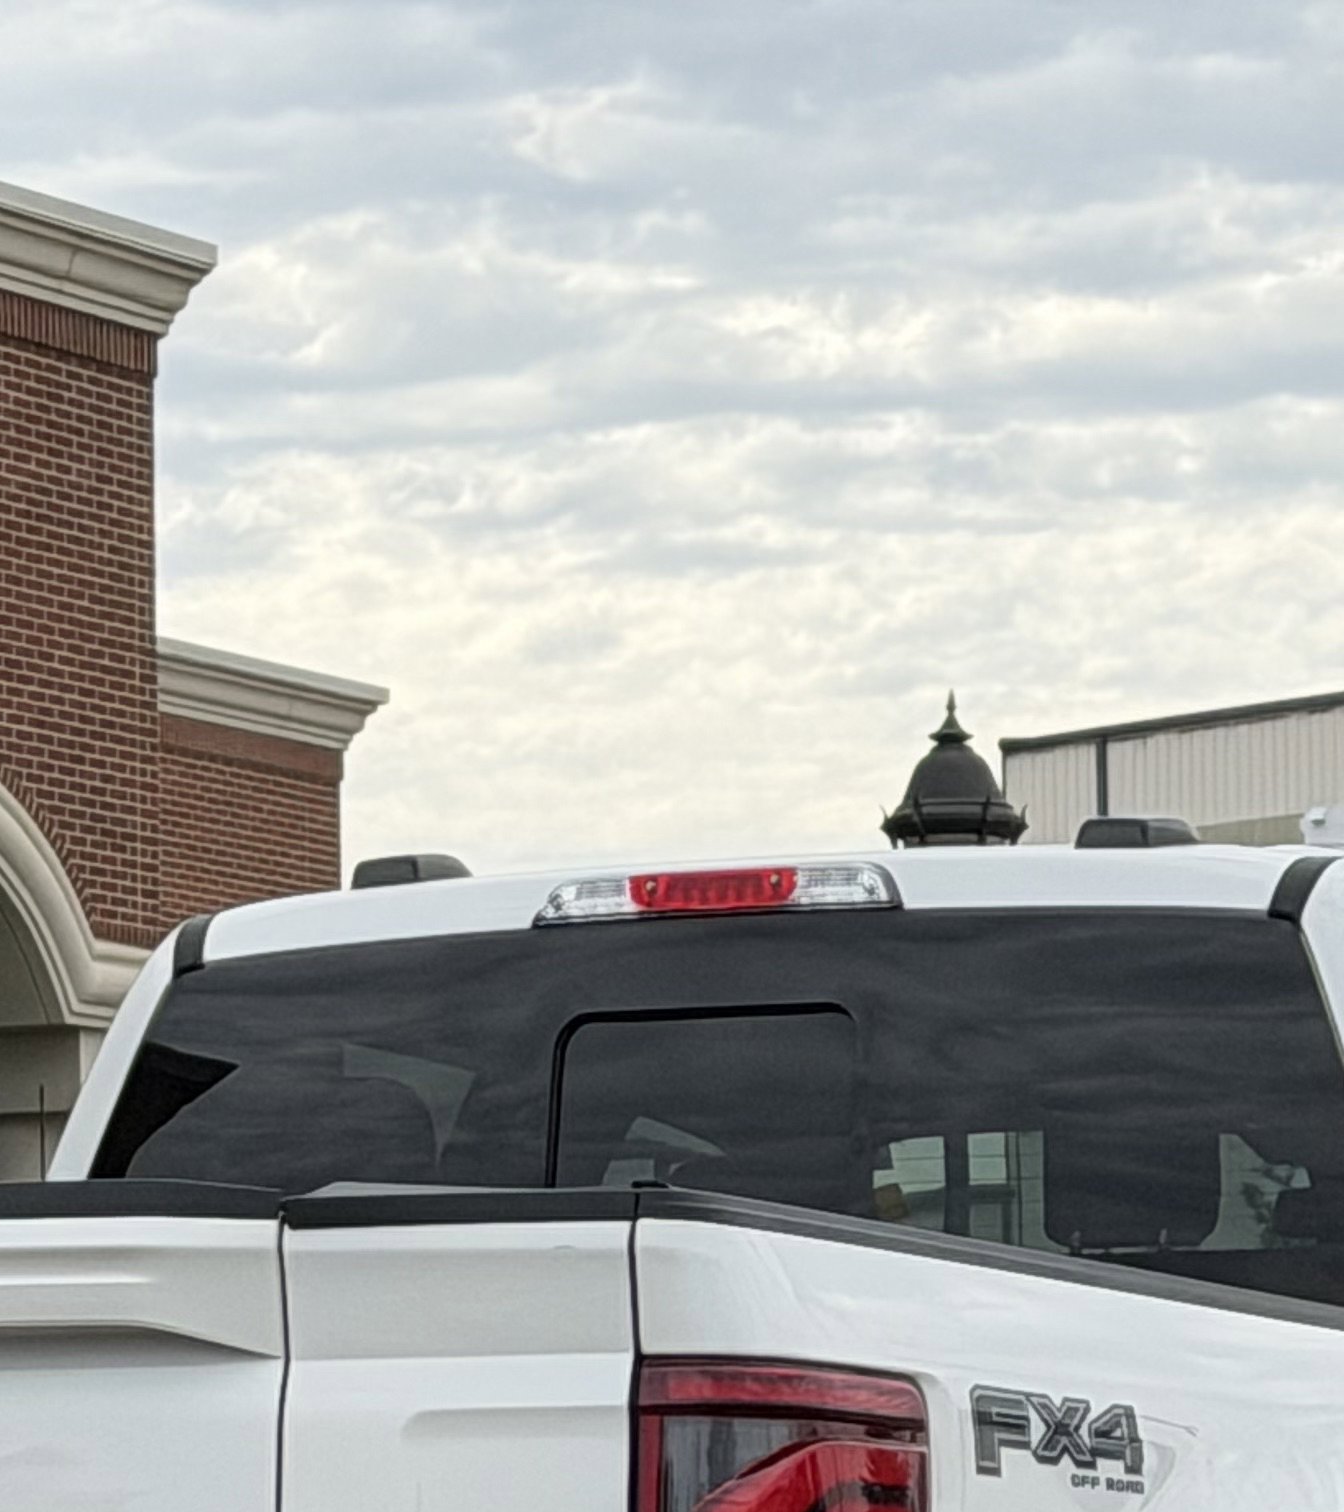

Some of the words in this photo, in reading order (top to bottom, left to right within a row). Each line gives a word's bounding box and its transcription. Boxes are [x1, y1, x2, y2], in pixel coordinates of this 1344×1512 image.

[969, 1384, 1144, 1477] FX4
[1070, 1473, 1100, 1490] OFF
[1106, 1477, 1145, 1495] ROAD
